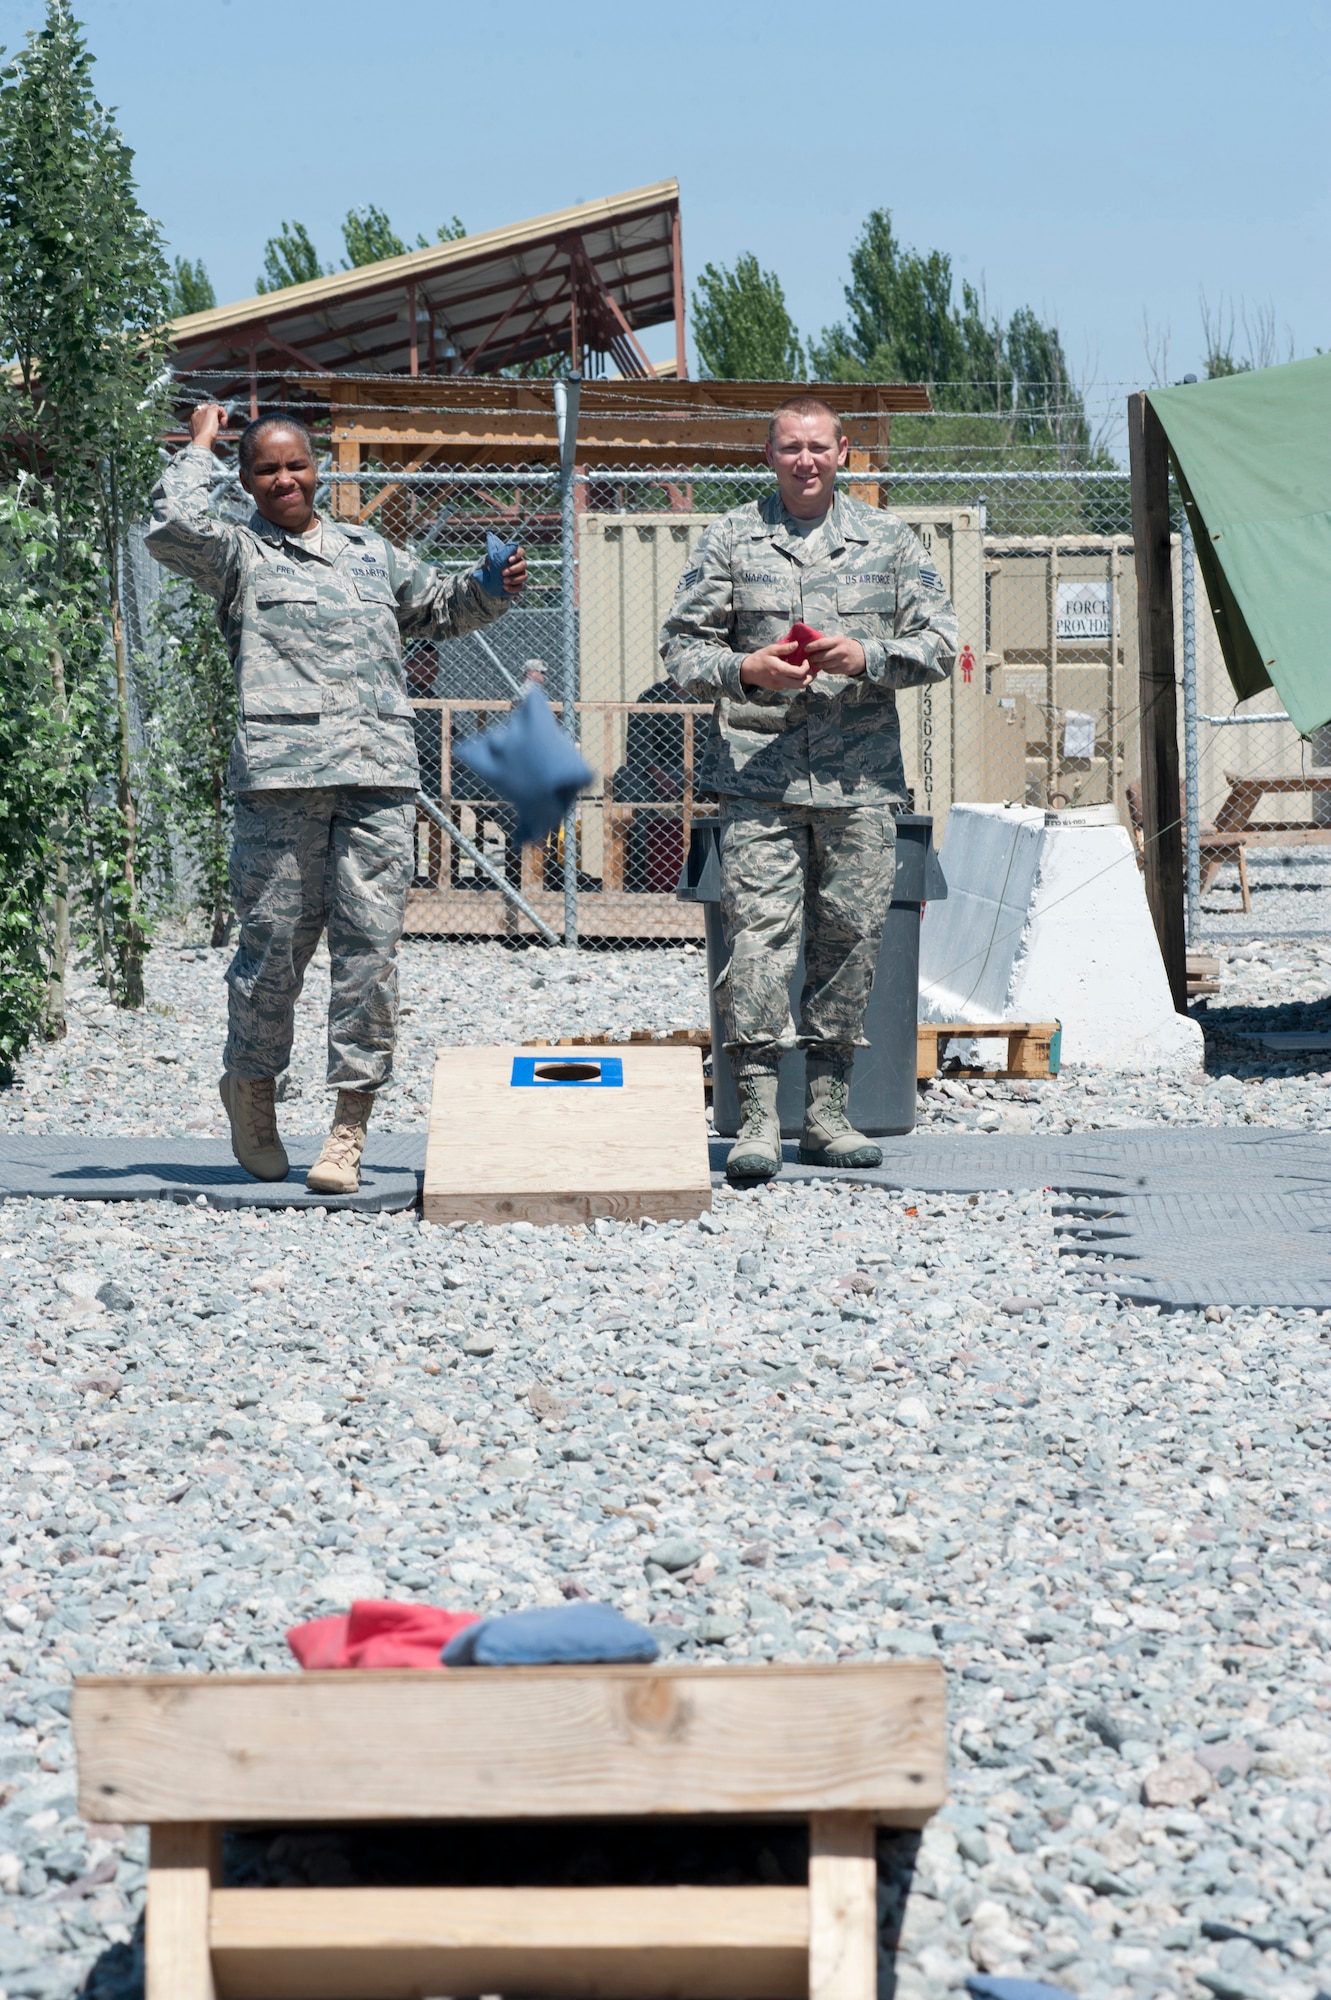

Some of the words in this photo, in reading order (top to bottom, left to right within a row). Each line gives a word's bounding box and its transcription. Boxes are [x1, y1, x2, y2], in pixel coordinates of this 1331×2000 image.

[276, 565, 296, 576] FREY
[859, 574, 871, 583] AIR
[872, 574, 890, 584] FORCE
[1066, 600, 1111, 615] FORCE
[1056, 618, 1119, 633] PROVIDE
